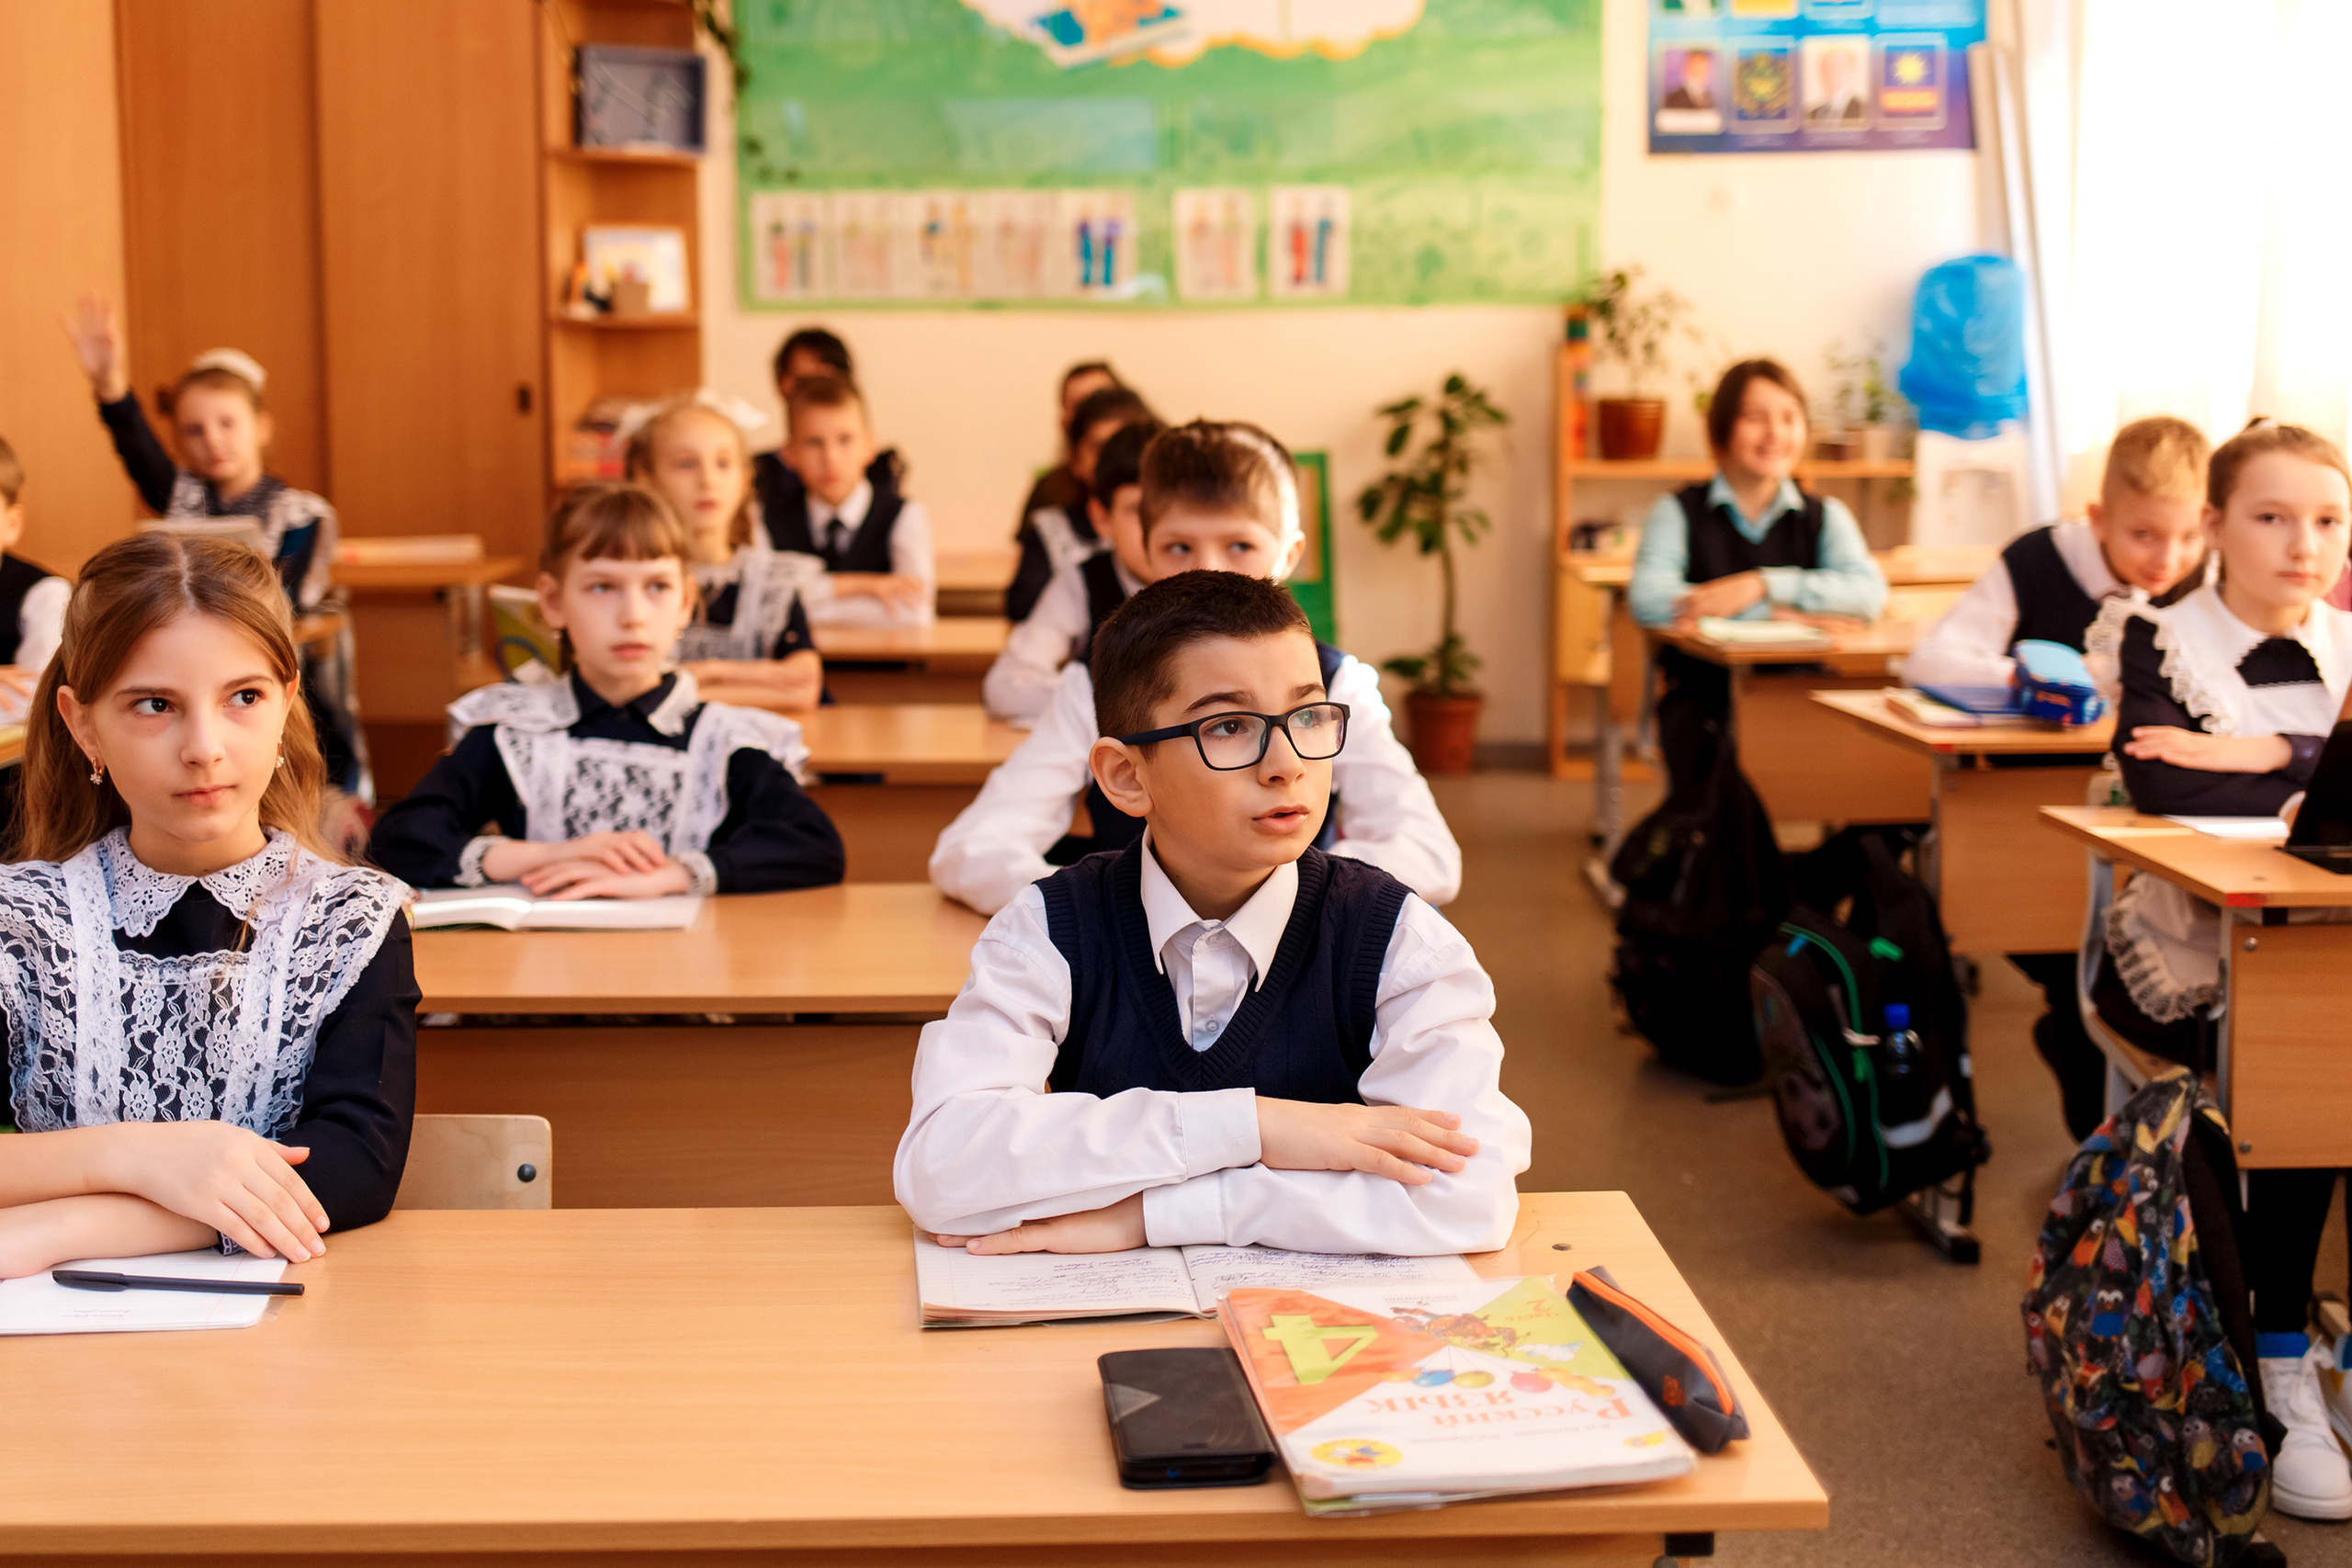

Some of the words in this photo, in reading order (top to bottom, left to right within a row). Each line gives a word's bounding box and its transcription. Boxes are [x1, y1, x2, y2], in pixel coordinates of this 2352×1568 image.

[1526, 1299, 1553, 1312] 2
[1261, 1314, 1379, 1385] 4
[1431, 1396, 1634, 1428] Русский
